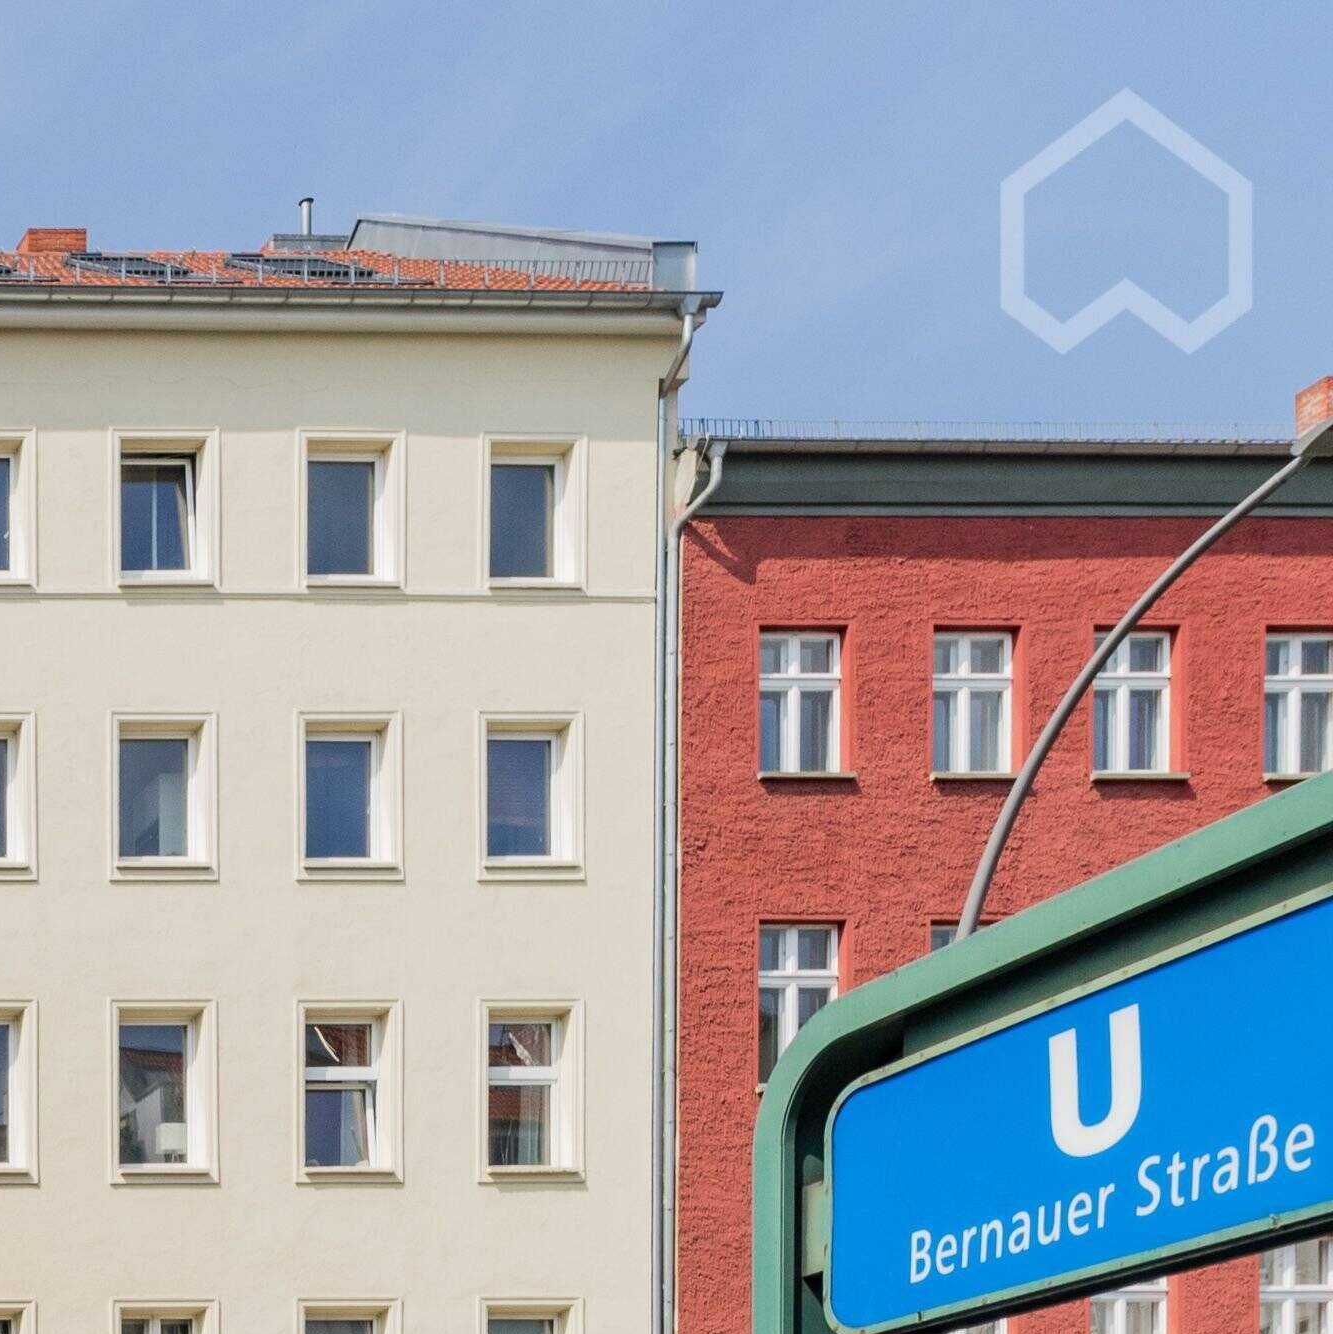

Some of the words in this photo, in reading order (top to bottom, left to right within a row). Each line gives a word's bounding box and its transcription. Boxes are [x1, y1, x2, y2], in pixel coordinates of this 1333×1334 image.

[1048, 1003, 1144, 1158] U
[910, 1182, 1116, 1285] Bernauer
[1136, 1113, 1316, 1218] Straße
